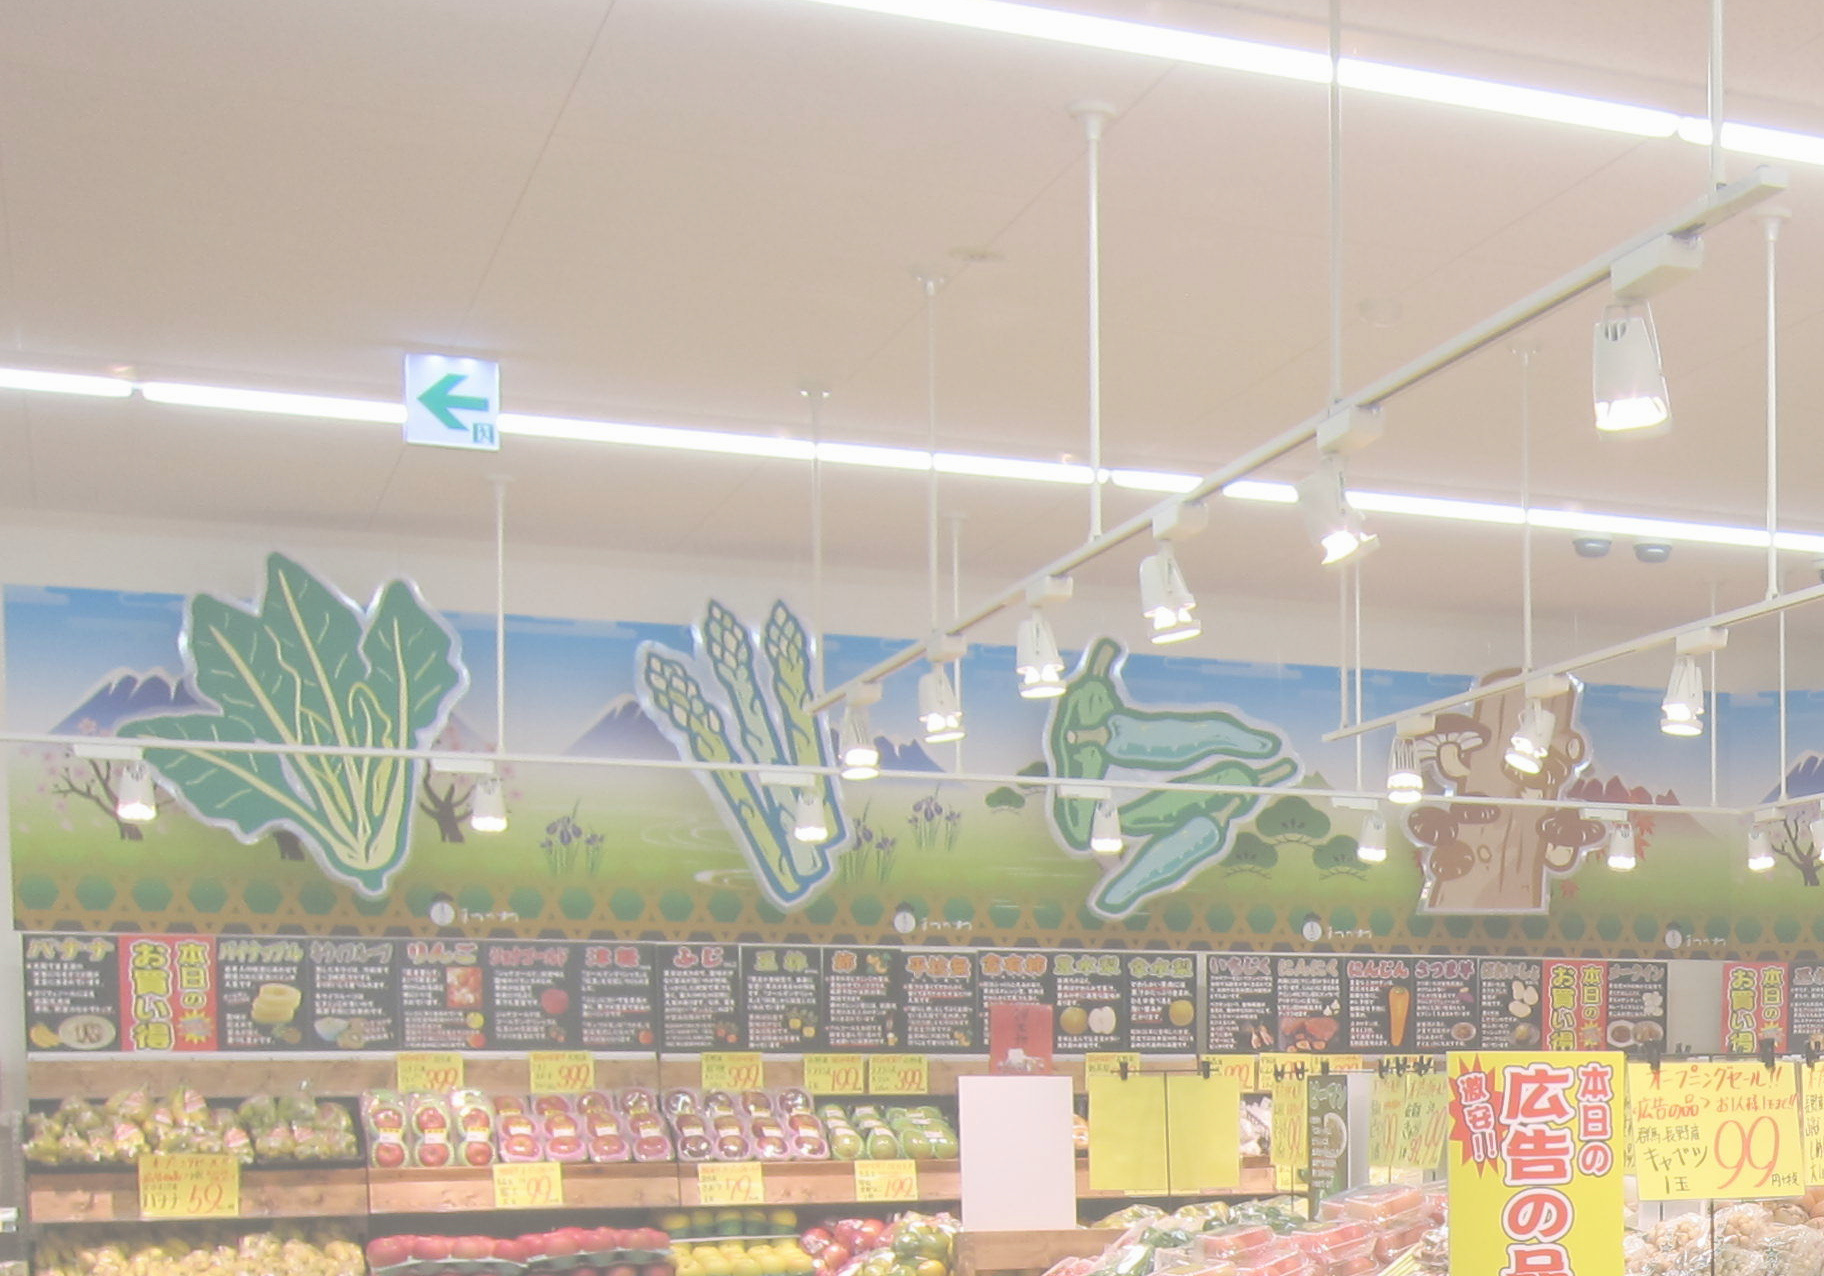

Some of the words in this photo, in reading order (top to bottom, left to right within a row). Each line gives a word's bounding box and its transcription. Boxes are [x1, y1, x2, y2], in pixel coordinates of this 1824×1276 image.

[174, 939, 209, 1009] 本日の
[673, 946, 724, 968] ふじ
[1347, 960, 1410, 979] にんじん
[130, 939, 173, 1050] お買い得
[1549, 964, 1577, 1050] お買い得
[1581, 964, 1603, 1019] 本日の
[1760, 966, 1783, 1020] 本日の
[1456, 1071, 1498, 1163] 激安!!
[1576, 1062, 1616, 1177] 本日の
[1643, 1145, 1709, 1172] キャベツ
[1714, 1115, 1781, 1190] 99
[187, 1183, 223, 1214] 59
